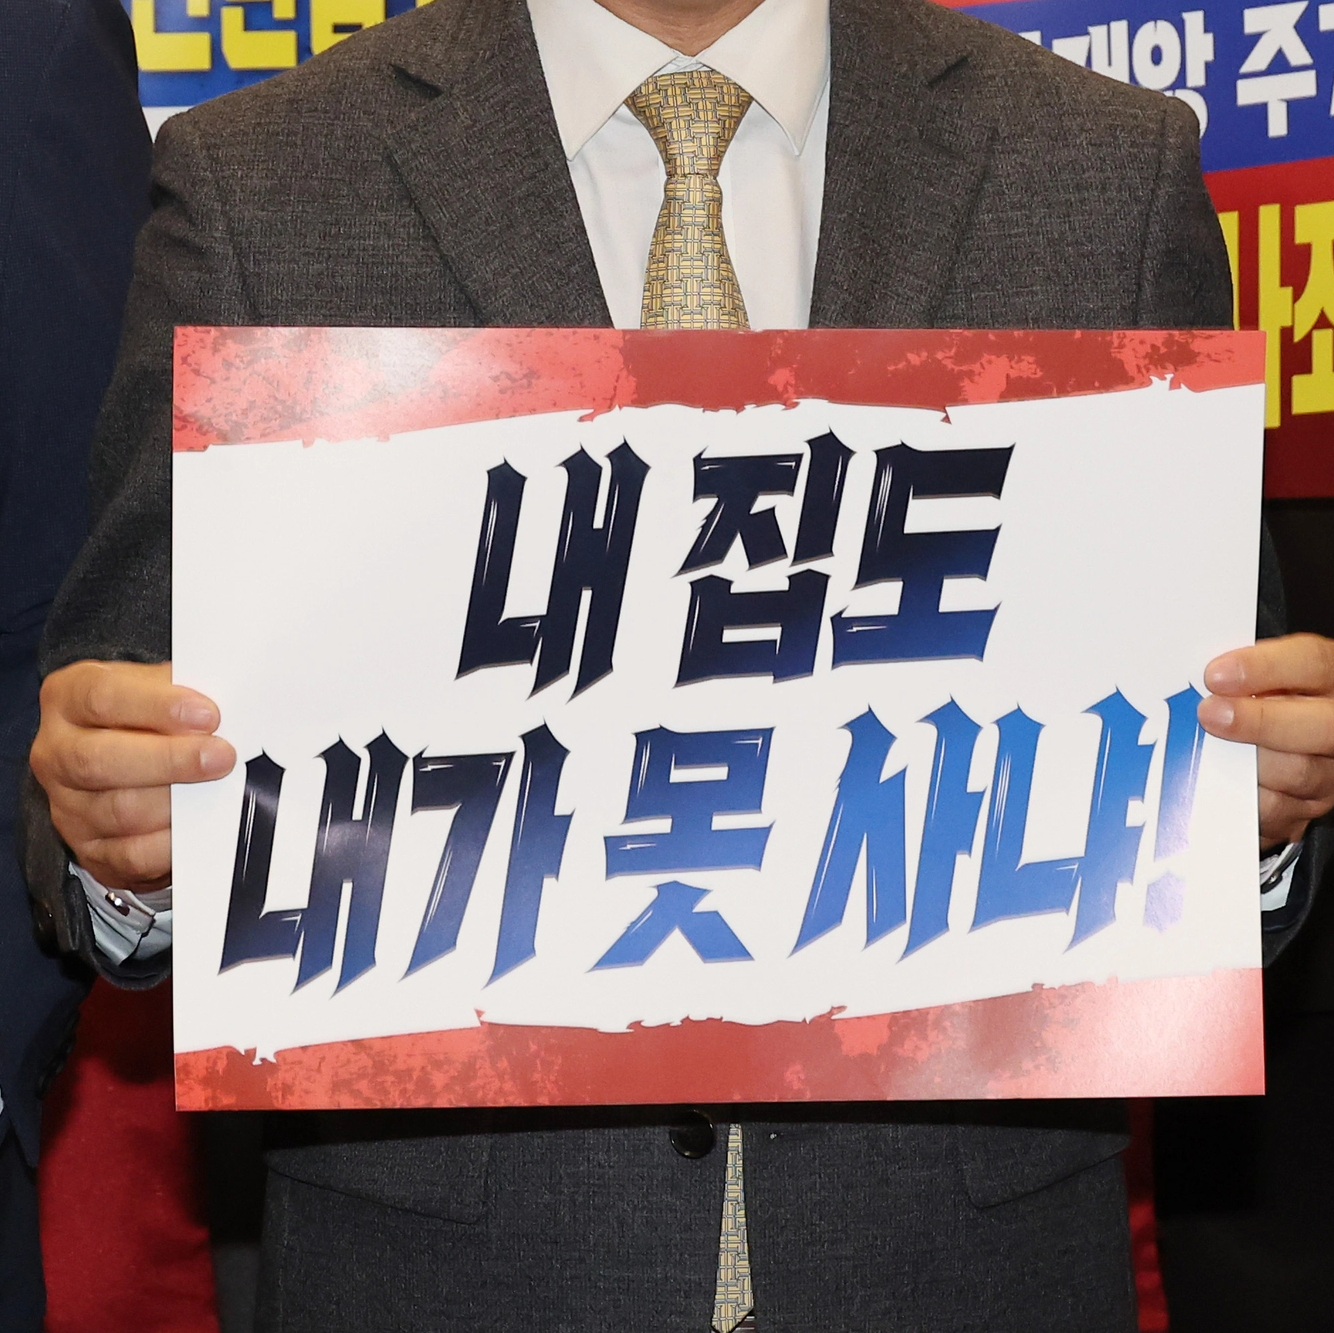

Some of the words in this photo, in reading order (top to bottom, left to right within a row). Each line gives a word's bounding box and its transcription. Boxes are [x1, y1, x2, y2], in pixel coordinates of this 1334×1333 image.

[456, 437, 651, 702] 내
[673, 429, 1016, 688] 집도
[218, 718, 575, 998] 내가
[587, 726, 776, 974] 못
[789, 683, 1207, 964] 사냐!
